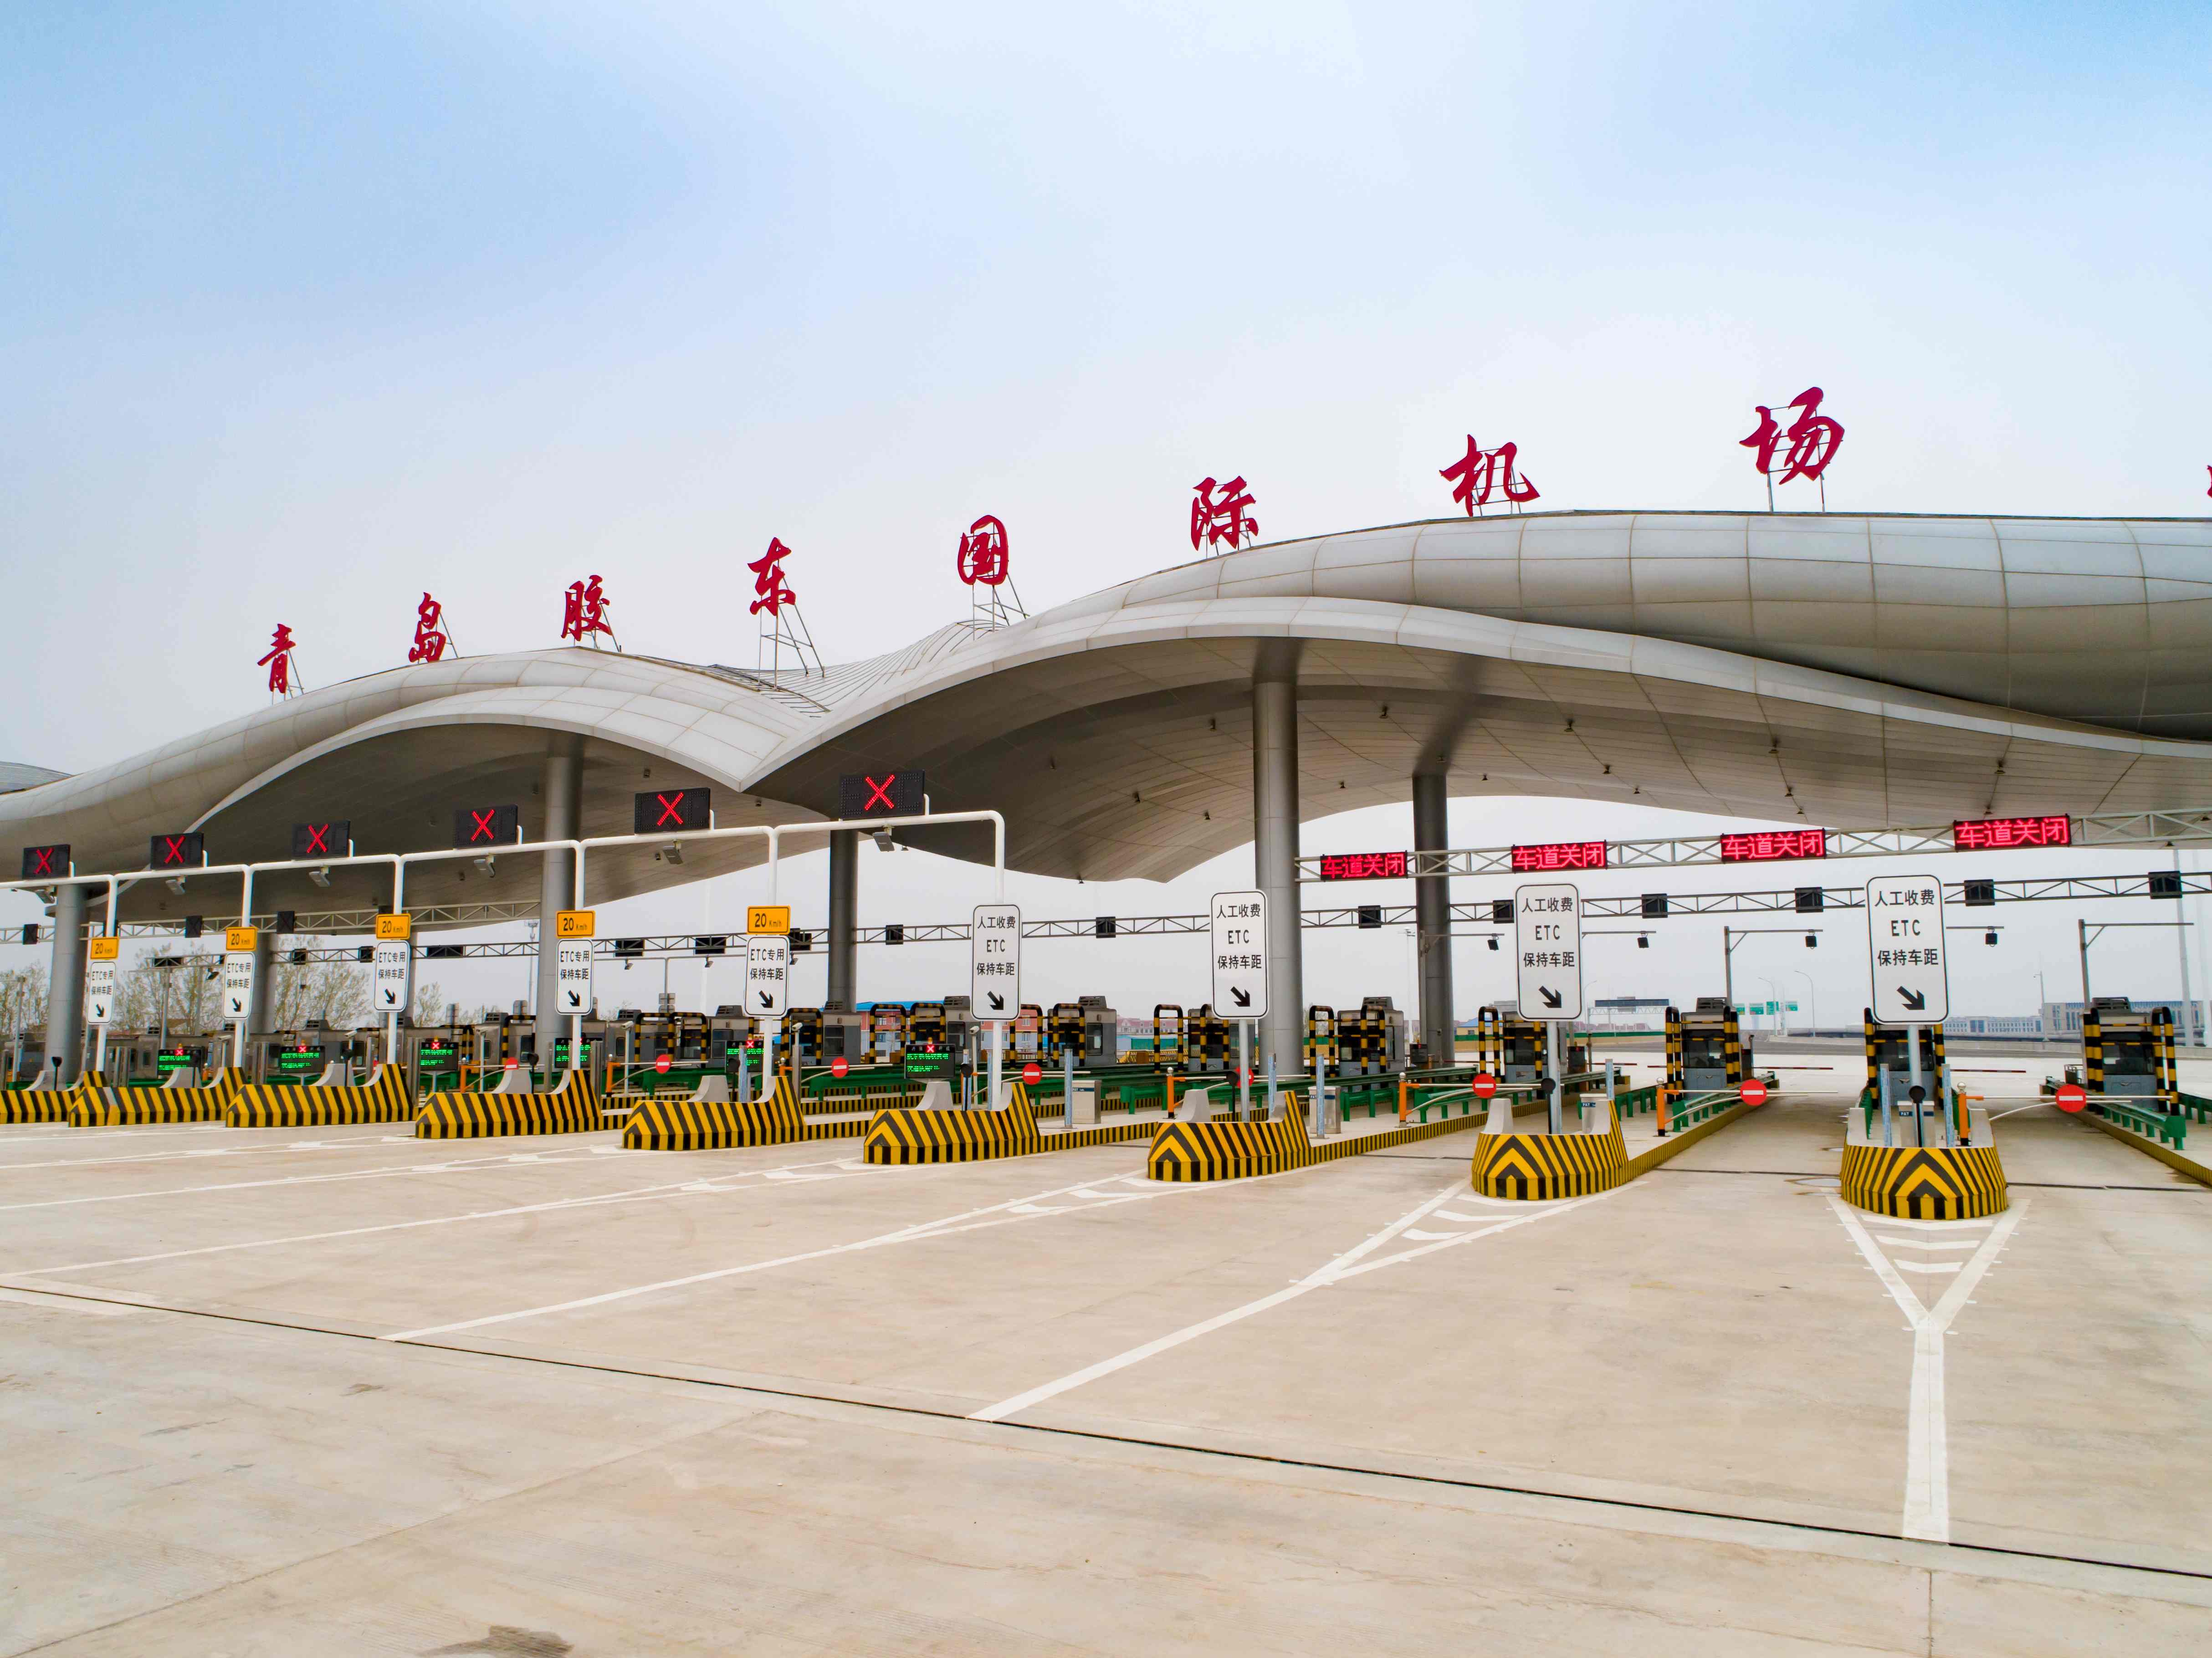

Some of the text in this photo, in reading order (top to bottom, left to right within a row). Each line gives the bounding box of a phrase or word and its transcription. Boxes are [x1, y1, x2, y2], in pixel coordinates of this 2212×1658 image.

[259, 388, 2212, 692] 青岛胶东国际机场
[1956, 819, 2068, 848] 车道关闭
[1722, 832, 1823, 860] 车道关闭
[1513, 844, 1605, 870] 车道关闭
[1322, 854, 1404, 878] 车道关闭
[1522, 897, 1572, 912] 人工收费
[1875, 889, 1934, 906] 人工收费
[1217, 904, 1260, 918] 人工收费
[382, 921, 391, 933] 20
[563, 918, 573, 931] 20
[755, 913, 766, 927] 20
[978, 916, 1015, 928] 人工收费
[1536, 925, 1560, 940] ETC
[1891, 920, 1920, 936] ETC
[231, 934, 239, 945] 20
[1228, 930, 1249, 944] ETC
[95, 943, 102, 954] 20
[987, 940, 1005, 952] ETC
[561, 951, 589, 962] ETC专用
[751, 949, 784, 961] ETC专用
[1218, 955, 1261, 969] 保持车距
[1524, 952, 1574, 967] 保持车距
[1878, 949, 1938, 966] 保持车距
[379, 969, 405, 979] 保持车距
[561, 968, 589, 980] 保持车距
[750, 968, 783, 980] 保持车距
[977, 962, 1014, 975] 保持车距
